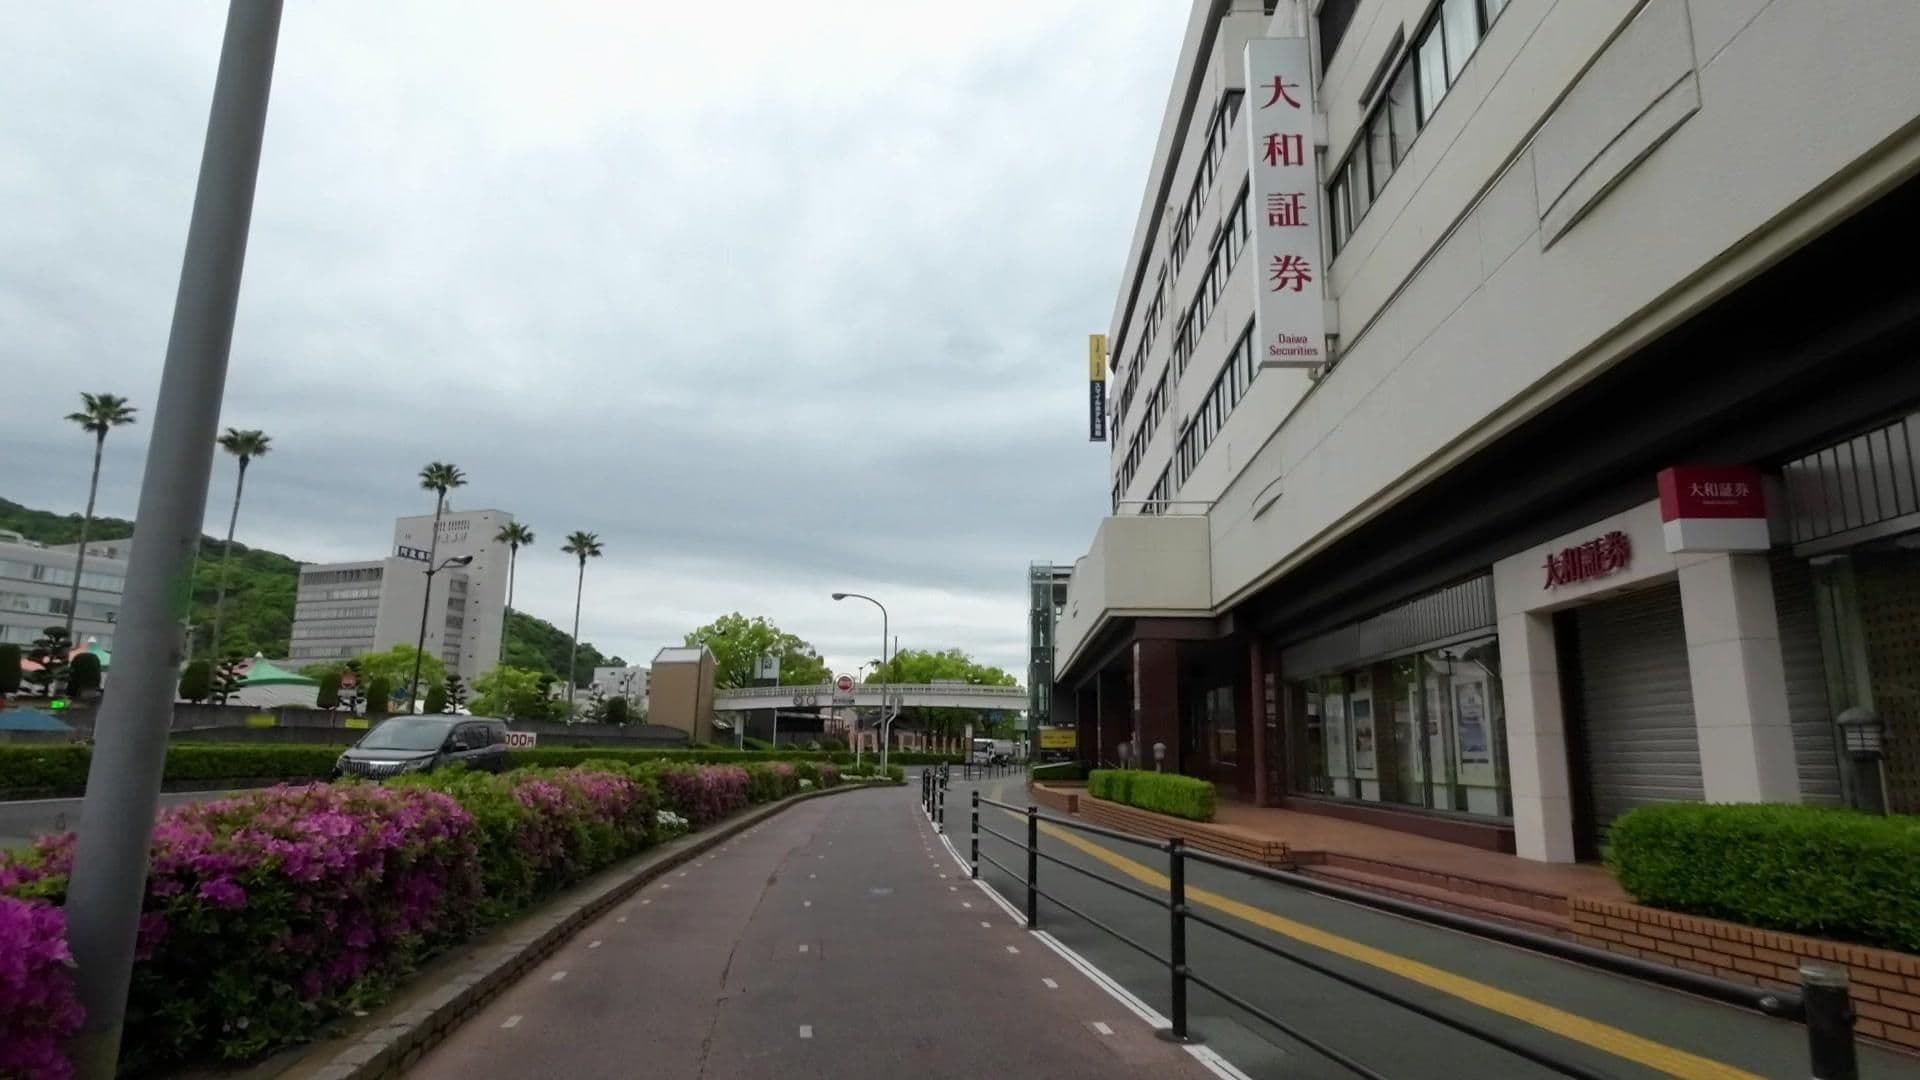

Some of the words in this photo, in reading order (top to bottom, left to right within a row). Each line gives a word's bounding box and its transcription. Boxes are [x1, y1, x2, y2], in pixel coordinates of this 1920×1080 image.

[1260, 75, 1313, 293] 大和証券
[1278, 333, 1308, 344] Daiwa
[1269, 345, 1319, 356] Securities
[1688, 482, 1751, 497] 大和証券
[1542, 530, 1631, 590] 大和証券
